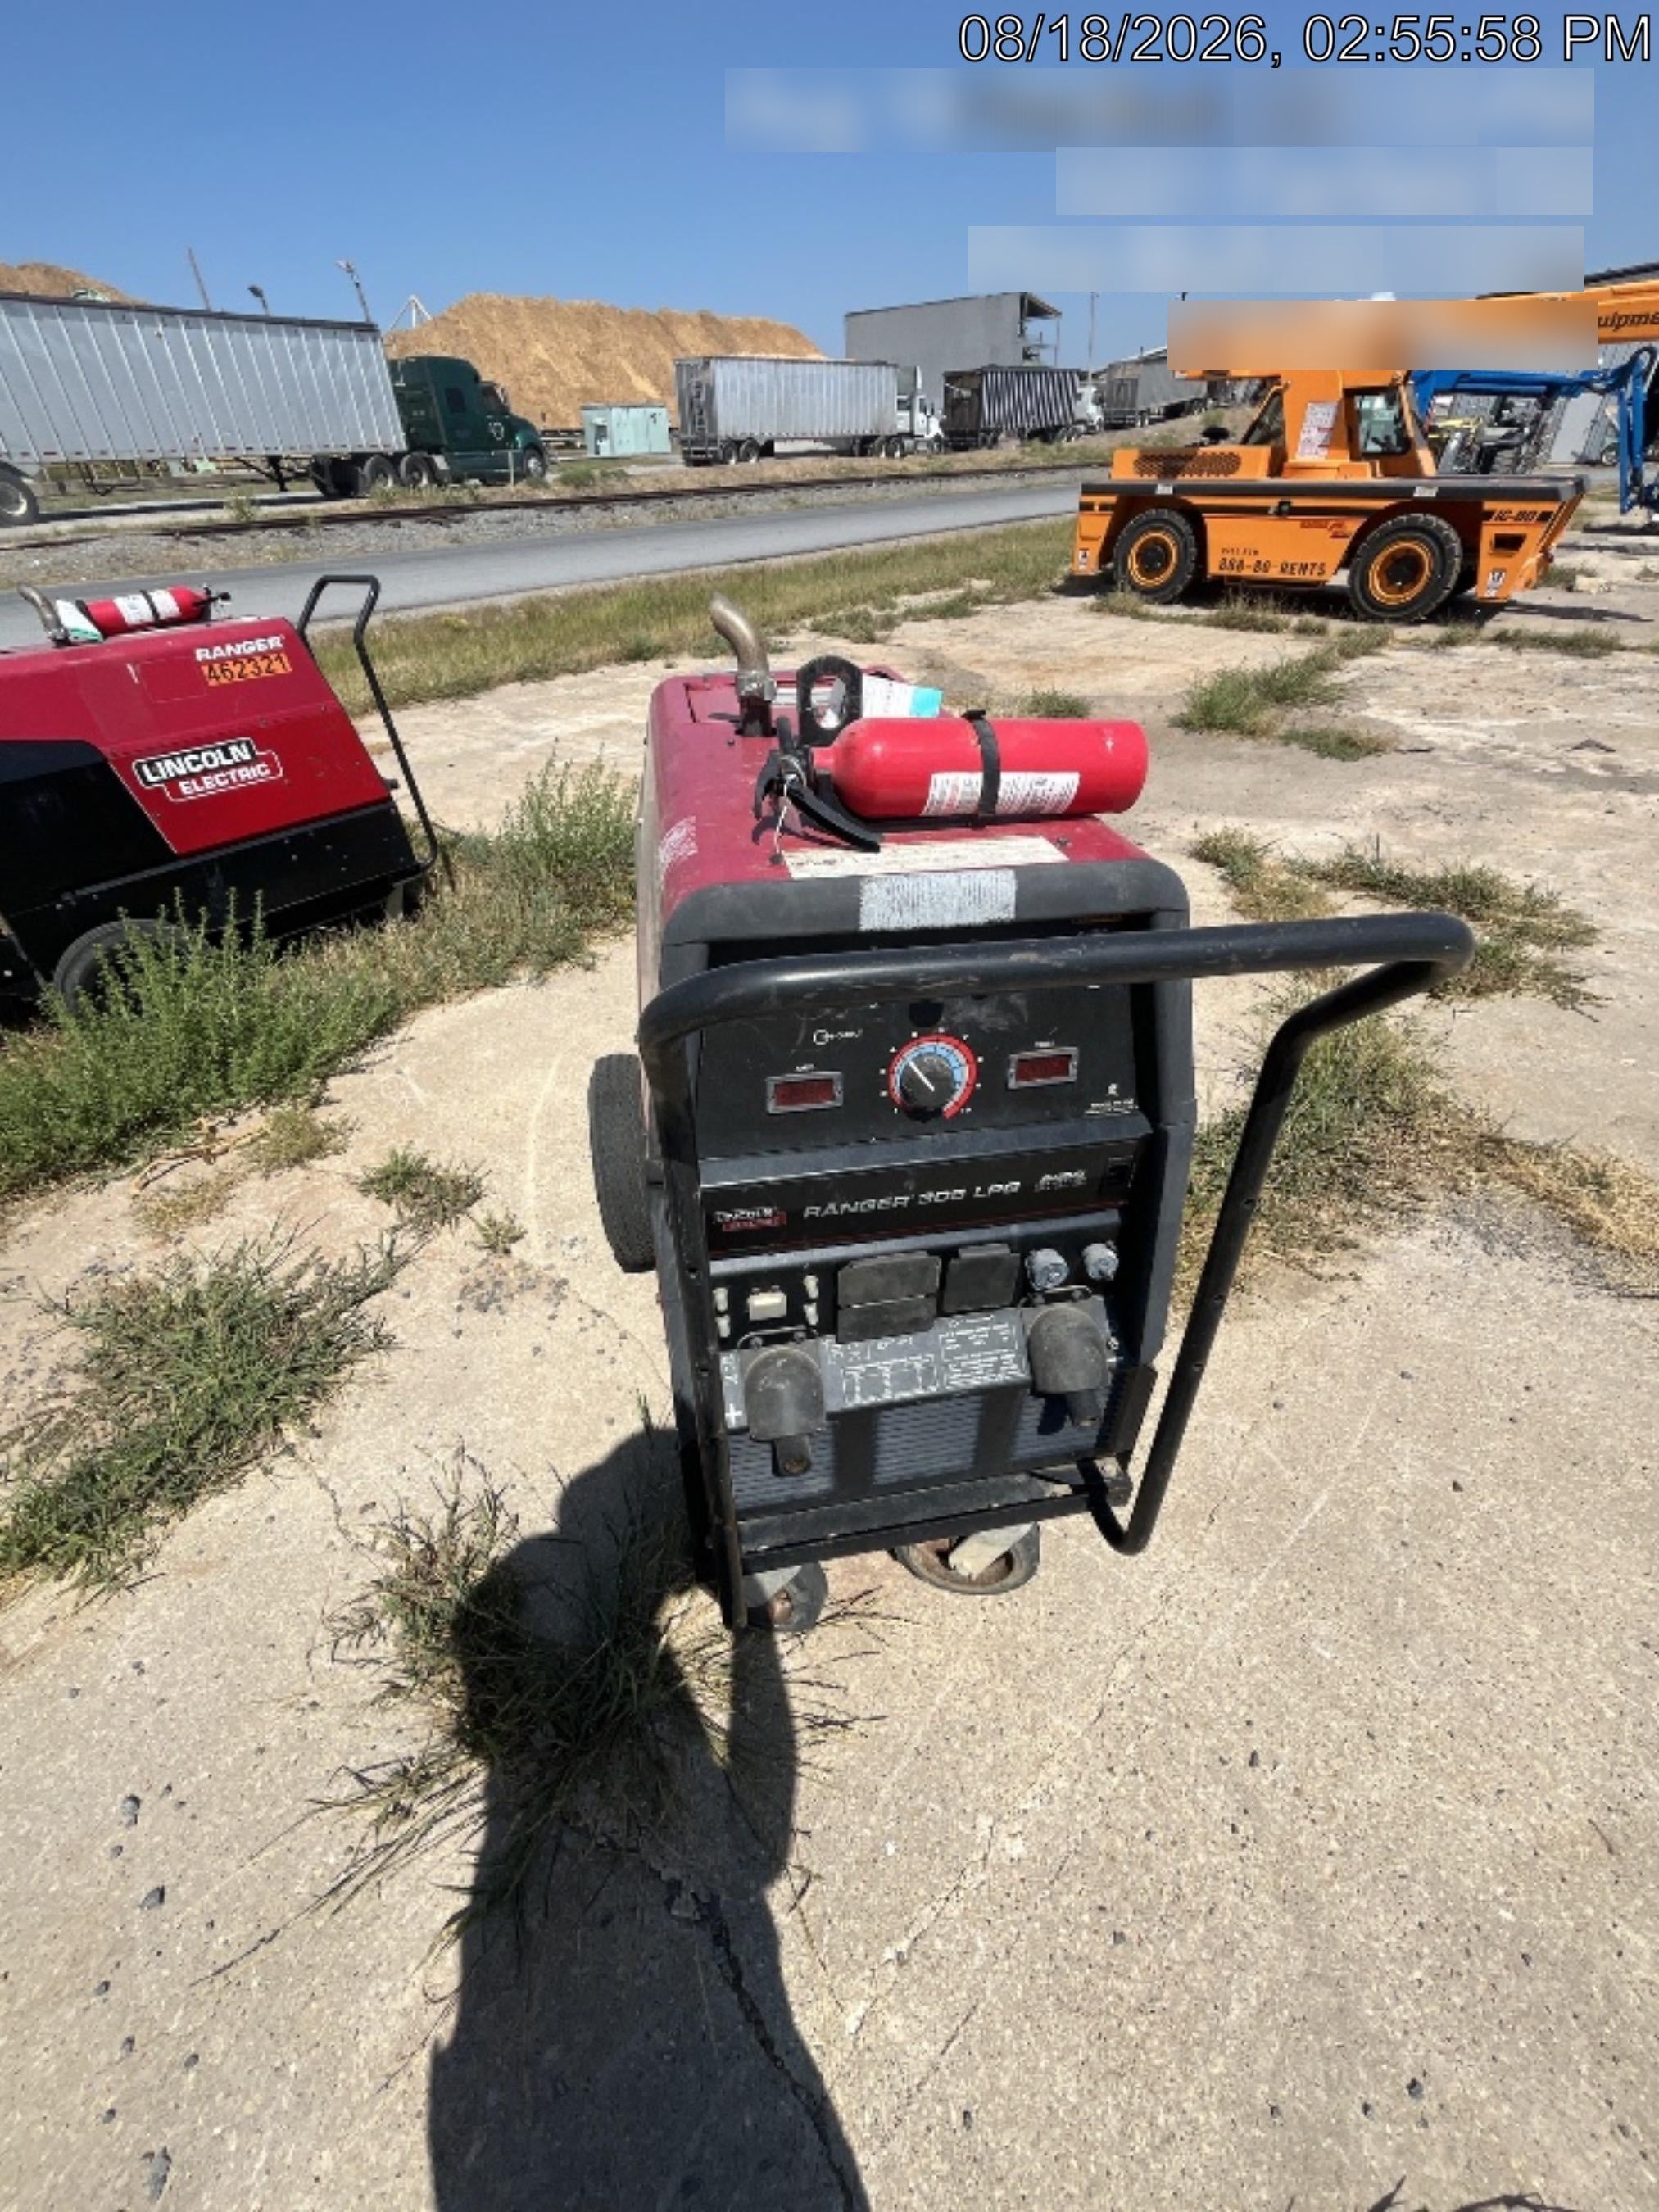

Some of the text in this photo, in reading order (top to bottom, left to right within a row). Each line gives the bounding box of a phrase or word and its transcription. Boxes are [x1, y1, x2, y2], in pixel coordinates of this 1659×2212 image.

[195, 635, 283, 662] RANGER
[207, 654, 289, 682] 462321
[141, 741, 252, 782] LINCOLN
[178, 762, 271, 795] ELECTRIC
[803, 1195, 911, 1220] RANGER
